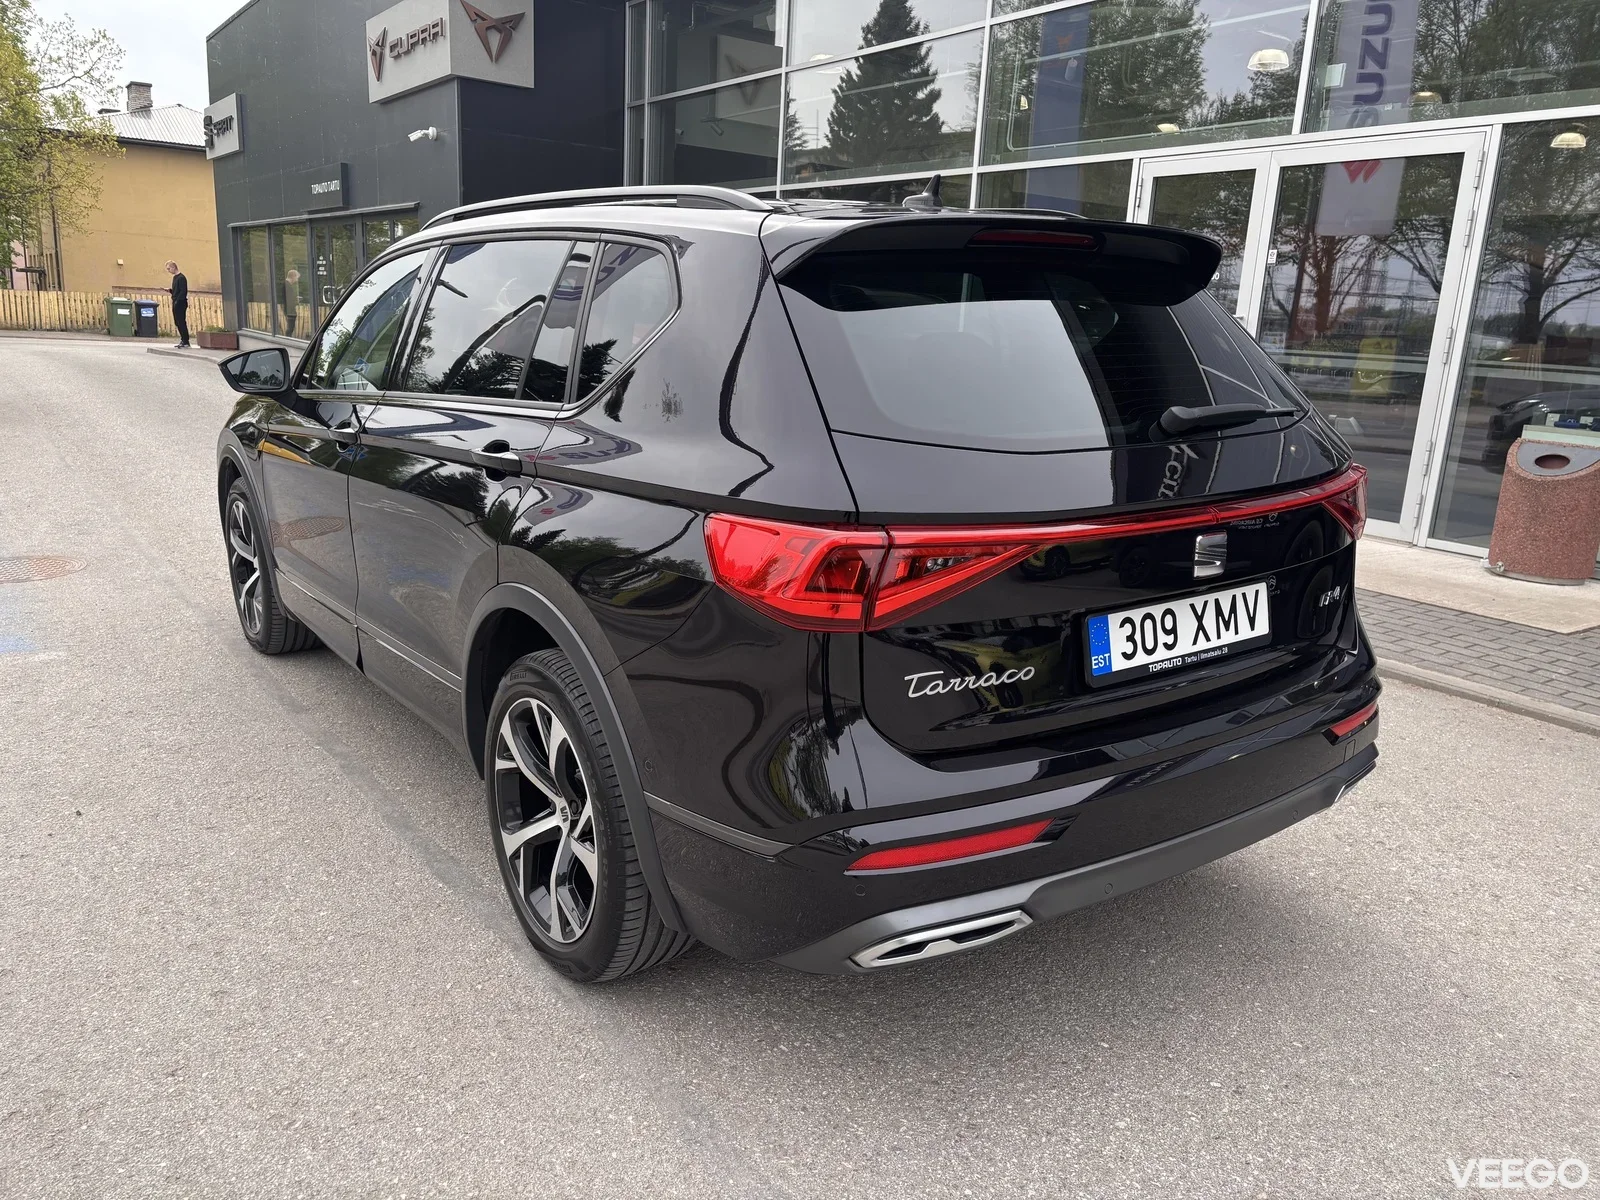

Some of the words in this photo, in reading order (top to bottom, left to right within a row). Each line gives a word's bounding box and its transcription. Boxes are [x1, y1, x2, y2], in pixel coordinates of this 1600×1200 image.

[389, 17, 444, 58] CUPRA
[1345, 0, 1393, 129] SUZU
[311, 182, 327, 195] TOPAUTO
[328, 180, 340, 191] TARTU
[1118, 607, 1179, 661] 309
[1189, 589, 1259, 646] XMV
[1091, 653, 1111, 669] EST
[1148, 657, 1182, 672] TOPAUTO
[1185, 655, 1198, 664] Tartu
[509, 669, 527, 681] PIRELLI
[904, 666, 1036, 698] Tarraco
